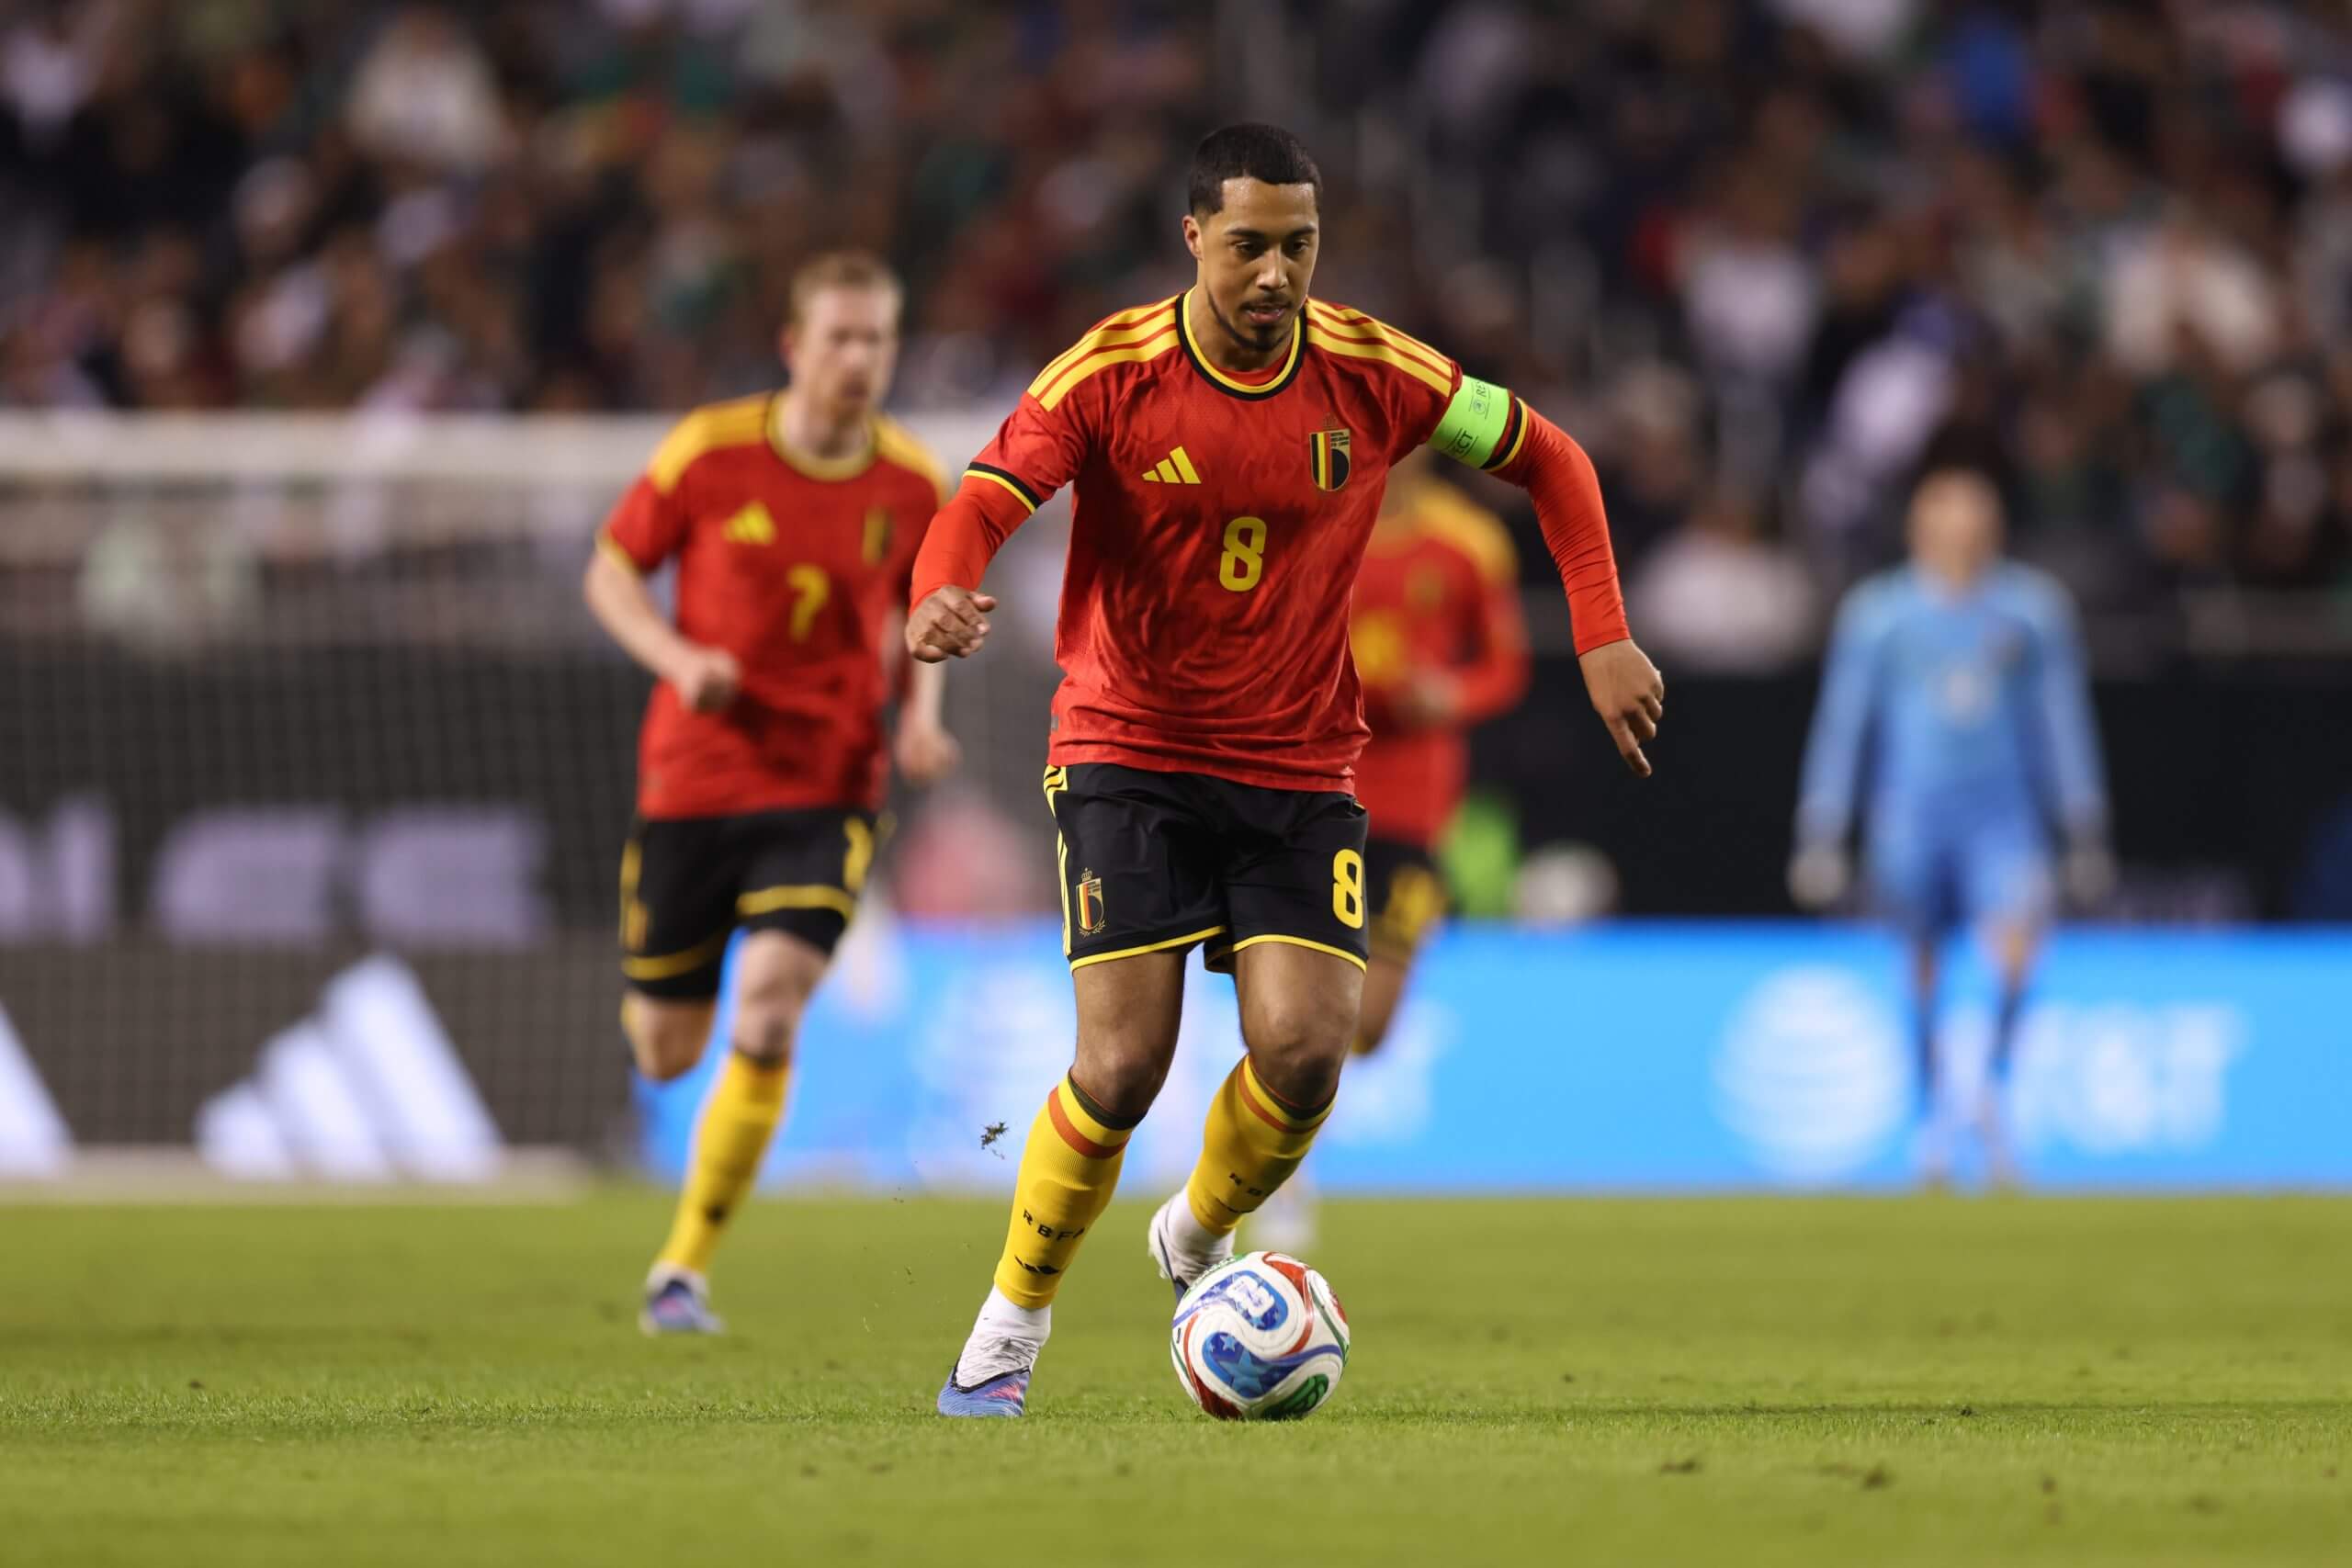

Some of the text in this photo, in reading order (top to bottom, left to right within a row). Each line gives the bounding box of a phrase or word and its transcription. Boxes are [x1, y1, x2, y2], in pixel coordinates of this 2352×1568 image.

[1219, 516, 1267, 592] 8
[786, 564, 829, 641] 7
[1333, 849, 1364, 930] 8
